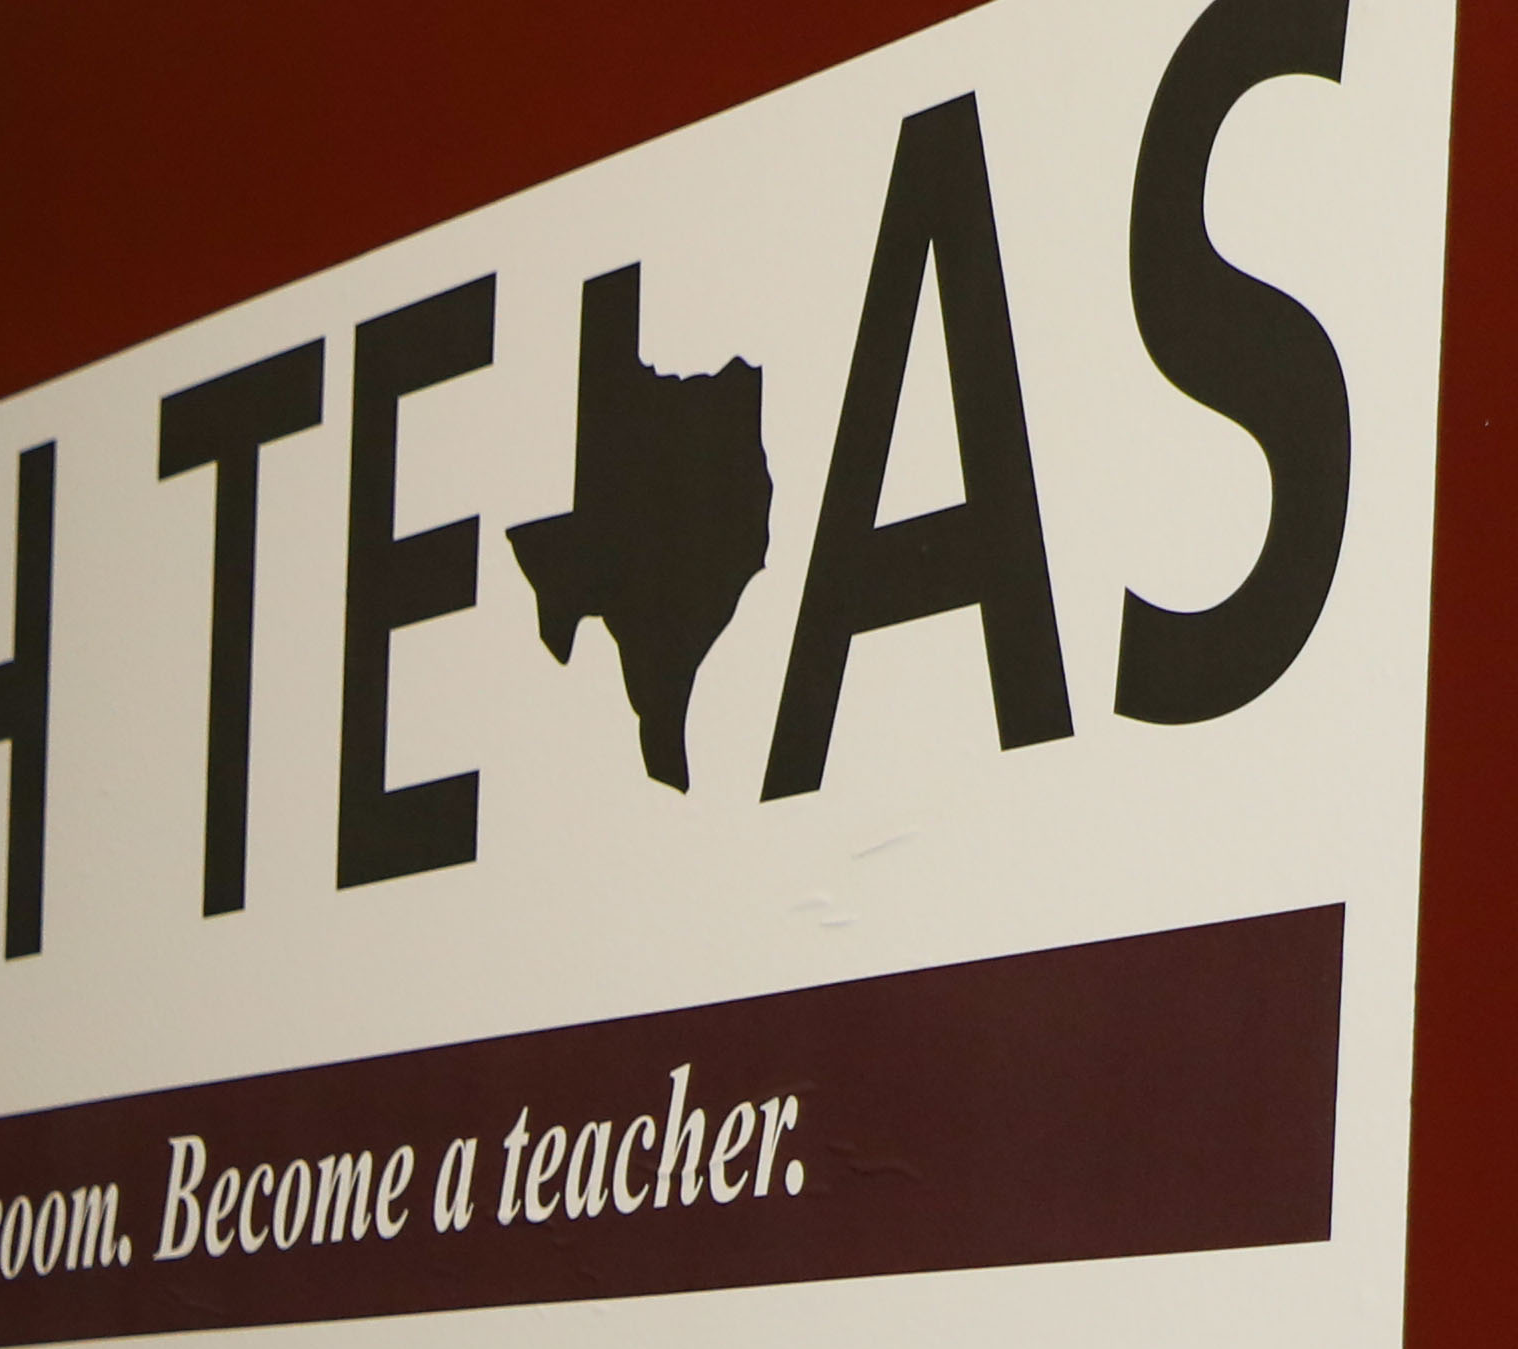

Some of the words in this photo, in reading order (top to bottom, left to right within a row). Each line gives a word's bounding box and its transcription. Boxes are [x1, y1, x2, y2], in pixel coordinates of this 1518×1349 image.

[153, 1134, 410, 1261] Become
[432, 1138, 478, 1233] a
[496, 1063, 806, 1226] teacher.
